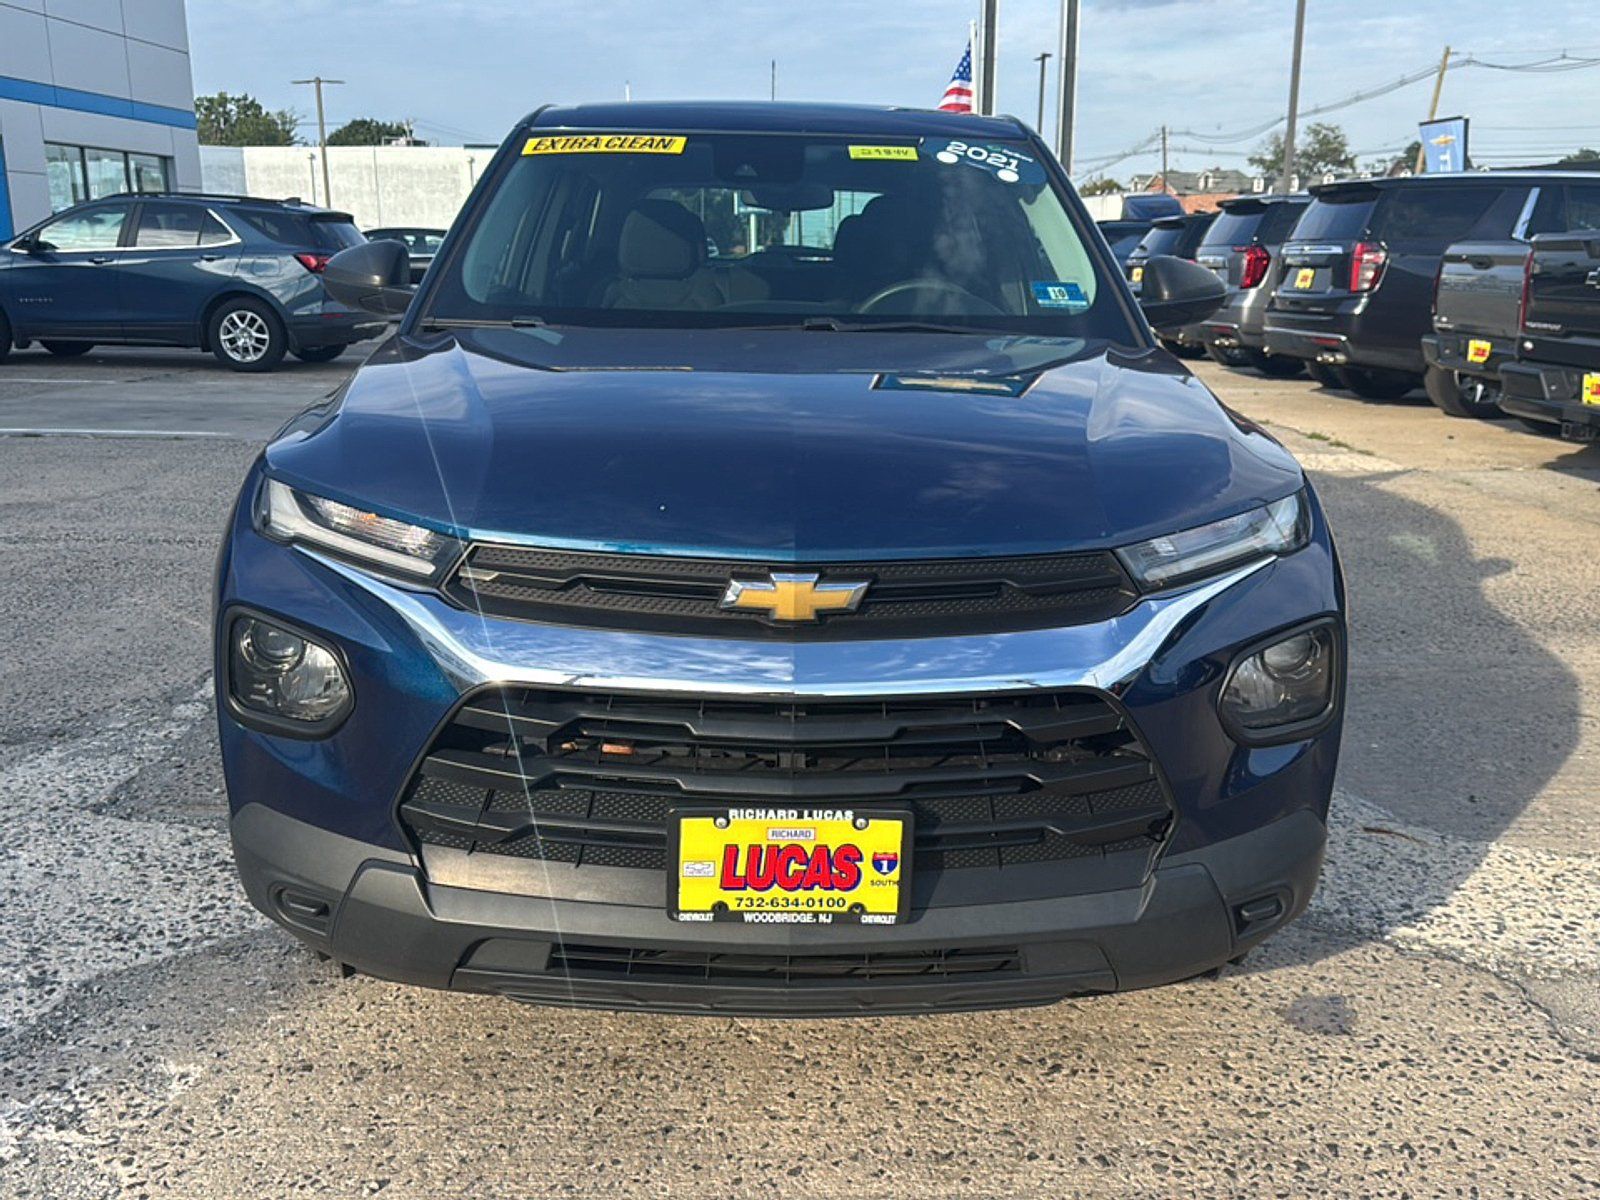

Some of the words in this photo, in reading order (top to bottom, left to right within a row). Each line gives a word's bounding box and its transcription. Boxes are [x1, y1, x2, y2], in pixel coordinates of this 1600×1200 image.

[532, 138, 601, 151] EXTRA
[946, 141, 1019, 172] 2021
[728, 808, 798, 821] RICHARD
[803, 809, 855, 821] LUCAS
[770, 829, 812, 839] RICHARD
[719, 843, 864, 892] LUCAS
[880, 859, 890, 873] 1
[818, 912, 833, 924] NJ
